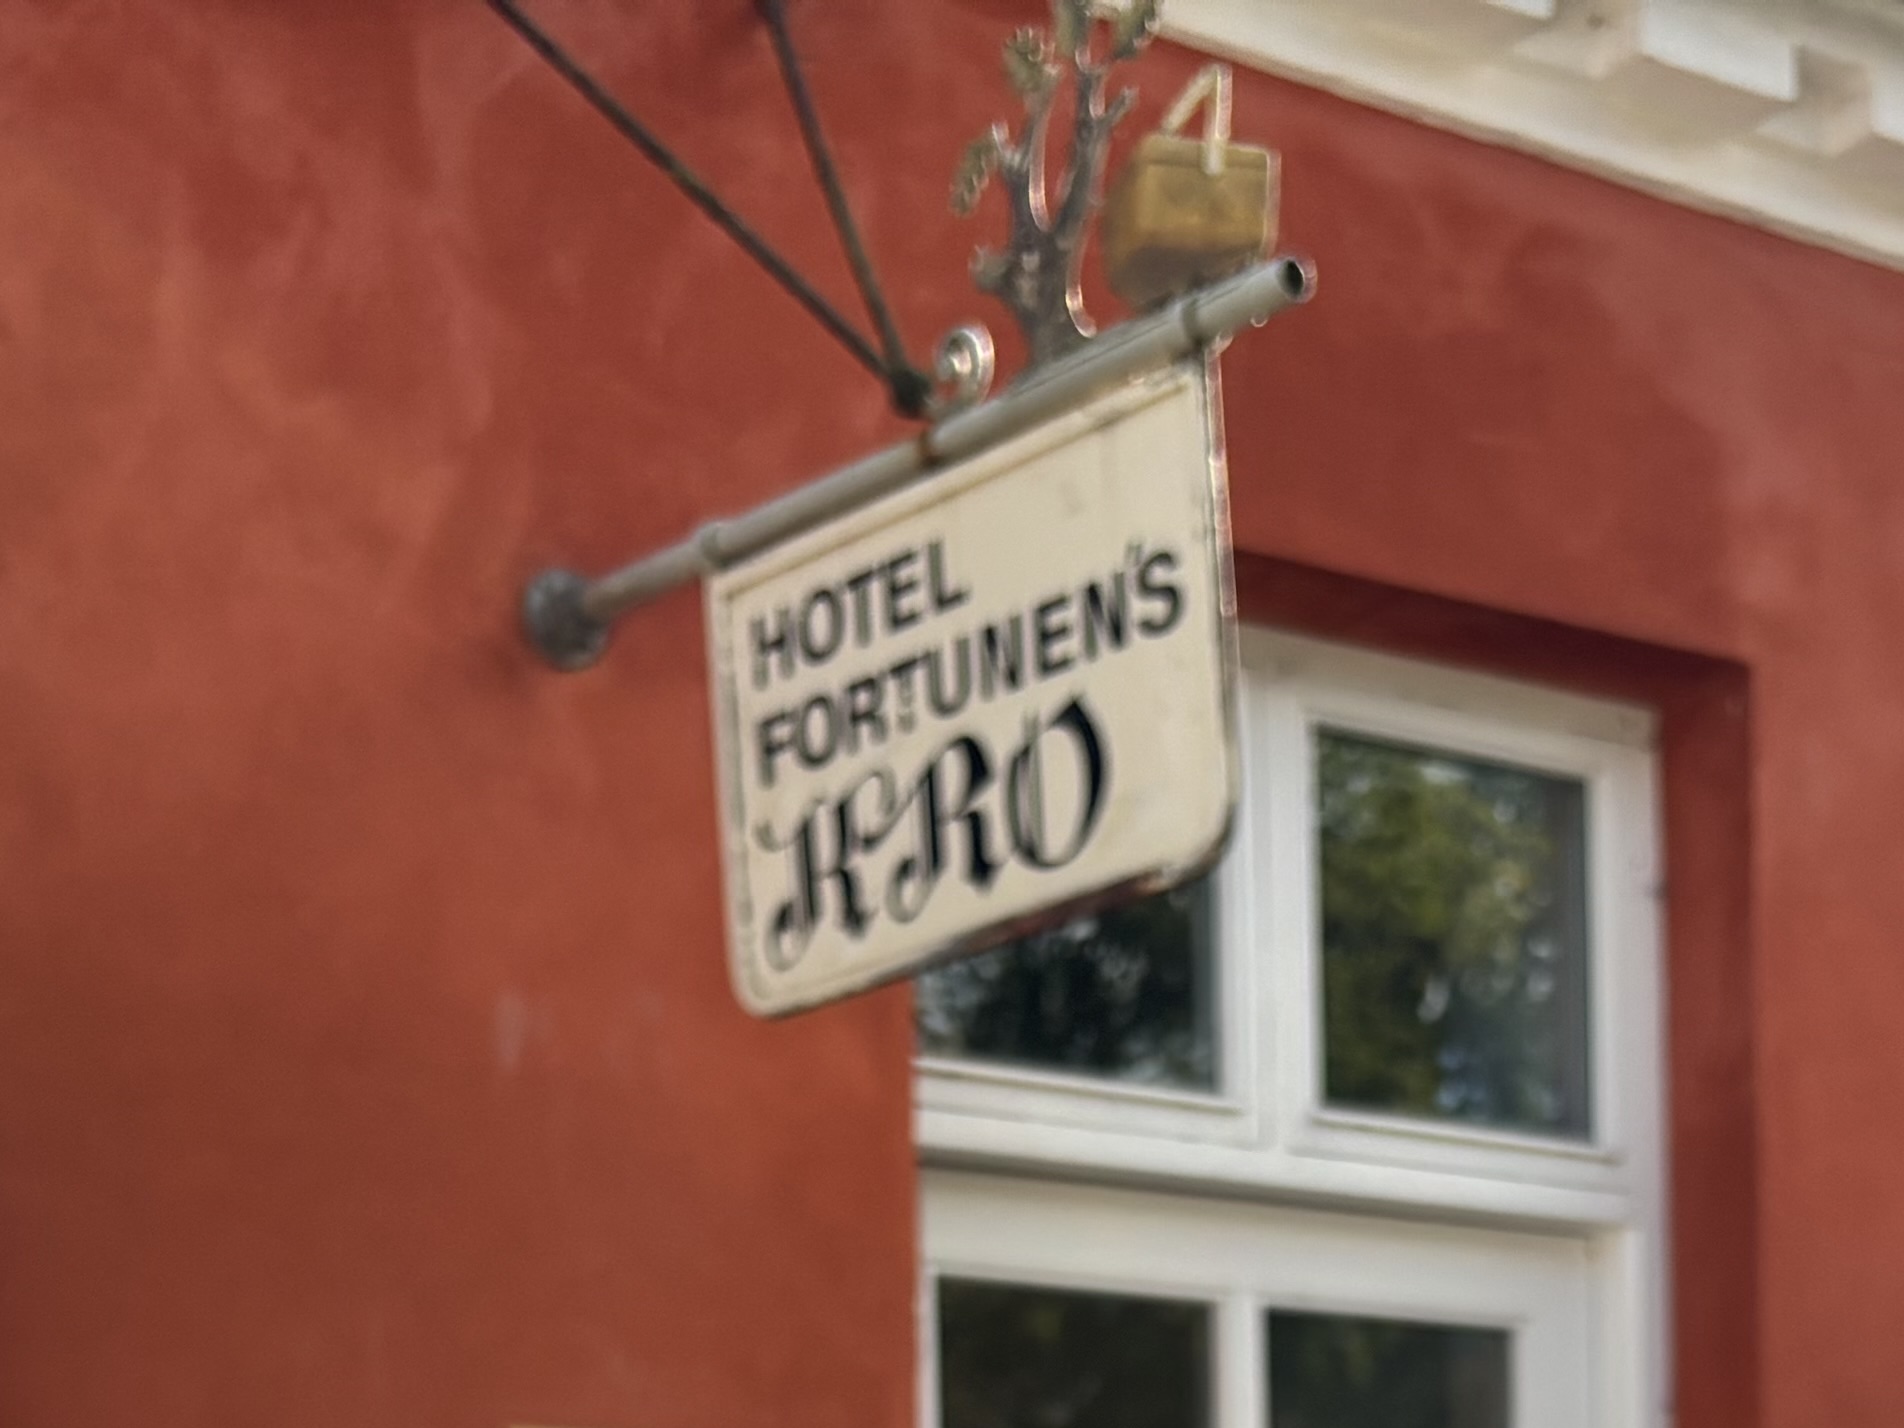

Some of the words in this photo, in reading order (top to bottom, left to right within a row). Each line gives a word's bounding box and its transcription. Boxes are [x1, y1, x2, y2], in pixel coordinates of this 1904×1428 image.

[749, 539, 969, 691] HOTEL
[756, 541, 1183, 788] FORTUNEN'S
[754, 696, 1111, 971] KRO
